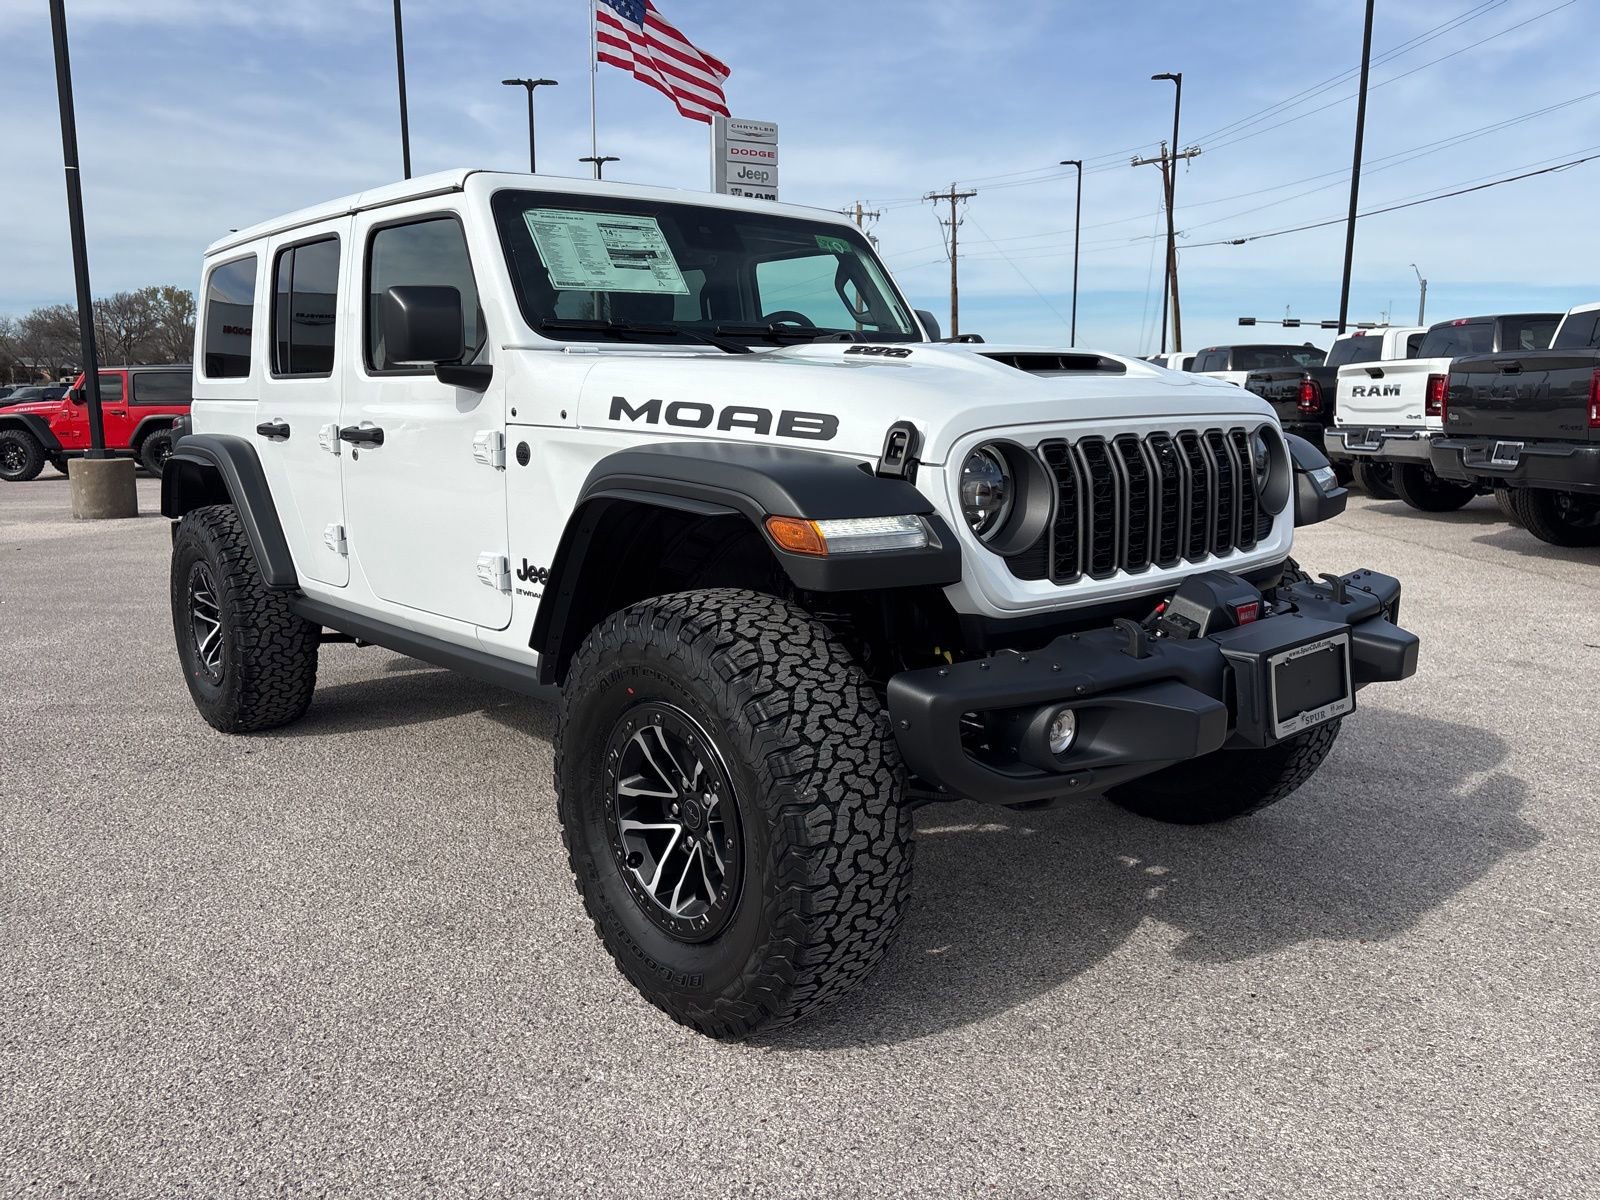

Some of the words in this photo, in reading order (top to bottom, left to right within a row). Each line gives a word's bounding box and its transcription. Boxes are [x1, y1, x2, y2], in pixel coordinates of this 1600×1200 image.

[730, 123, 775, 133] CHRYSLER
[730, 147, 775, 158] DODGE
[737, 165, 769, 183] Jeep
[744, 191, 776, 201] RAM
[843, 345, 914, 359] 392
[1352, 384, 1401, 397] RAM
[608, 395, 840, 442] MOAB
[516, 557, 550, 586] Jee
[1305, 710, 1326, 725] SPUR
